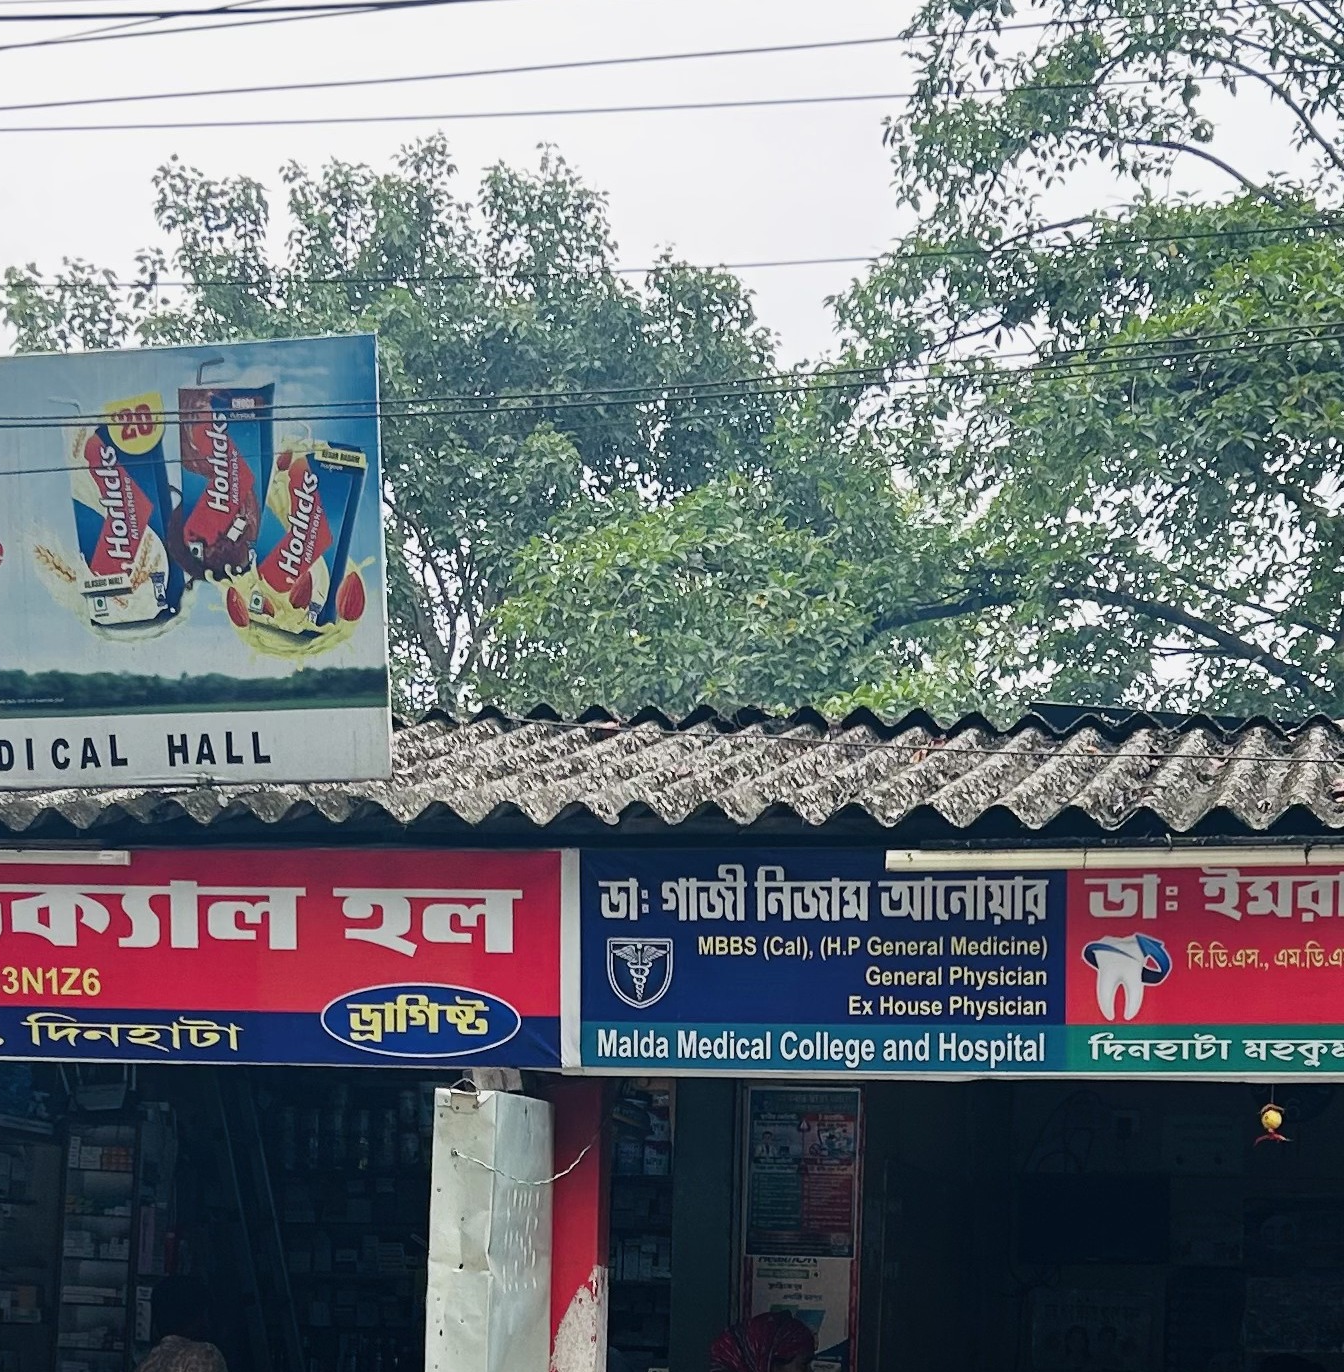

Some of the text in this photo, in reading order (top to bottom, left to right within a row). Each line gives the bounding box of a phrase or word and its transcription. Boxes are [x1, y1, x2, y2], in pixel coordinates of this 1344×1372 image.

[206, 413, 230, 512] Horlicks
[97, 446, 131, 559] Horlicks
[278, 472, 318, 576] Horlicks
[168, 731, 272, 767] HALL
[598, 863, 1048, 925] ডাঃ গাজী নিজাম আনোয়ার
[1085, 876, 1178, 919] ডাঃ
[332, 888, 522, 957] হল
[698, 936, 1047, 960] MBBS (Cal), (H.P General Medicine)
[866, 966, 1047, 991] General Physician
[848, 996, 1047, 1020] Ex House Physician
[22, 1012, 244, 1052] দিনহাটা
[597, 1030, 1045, 1068] Malda Medical College and Hospital
[1088, 1033, 1231, 1062] দিনহাটা
